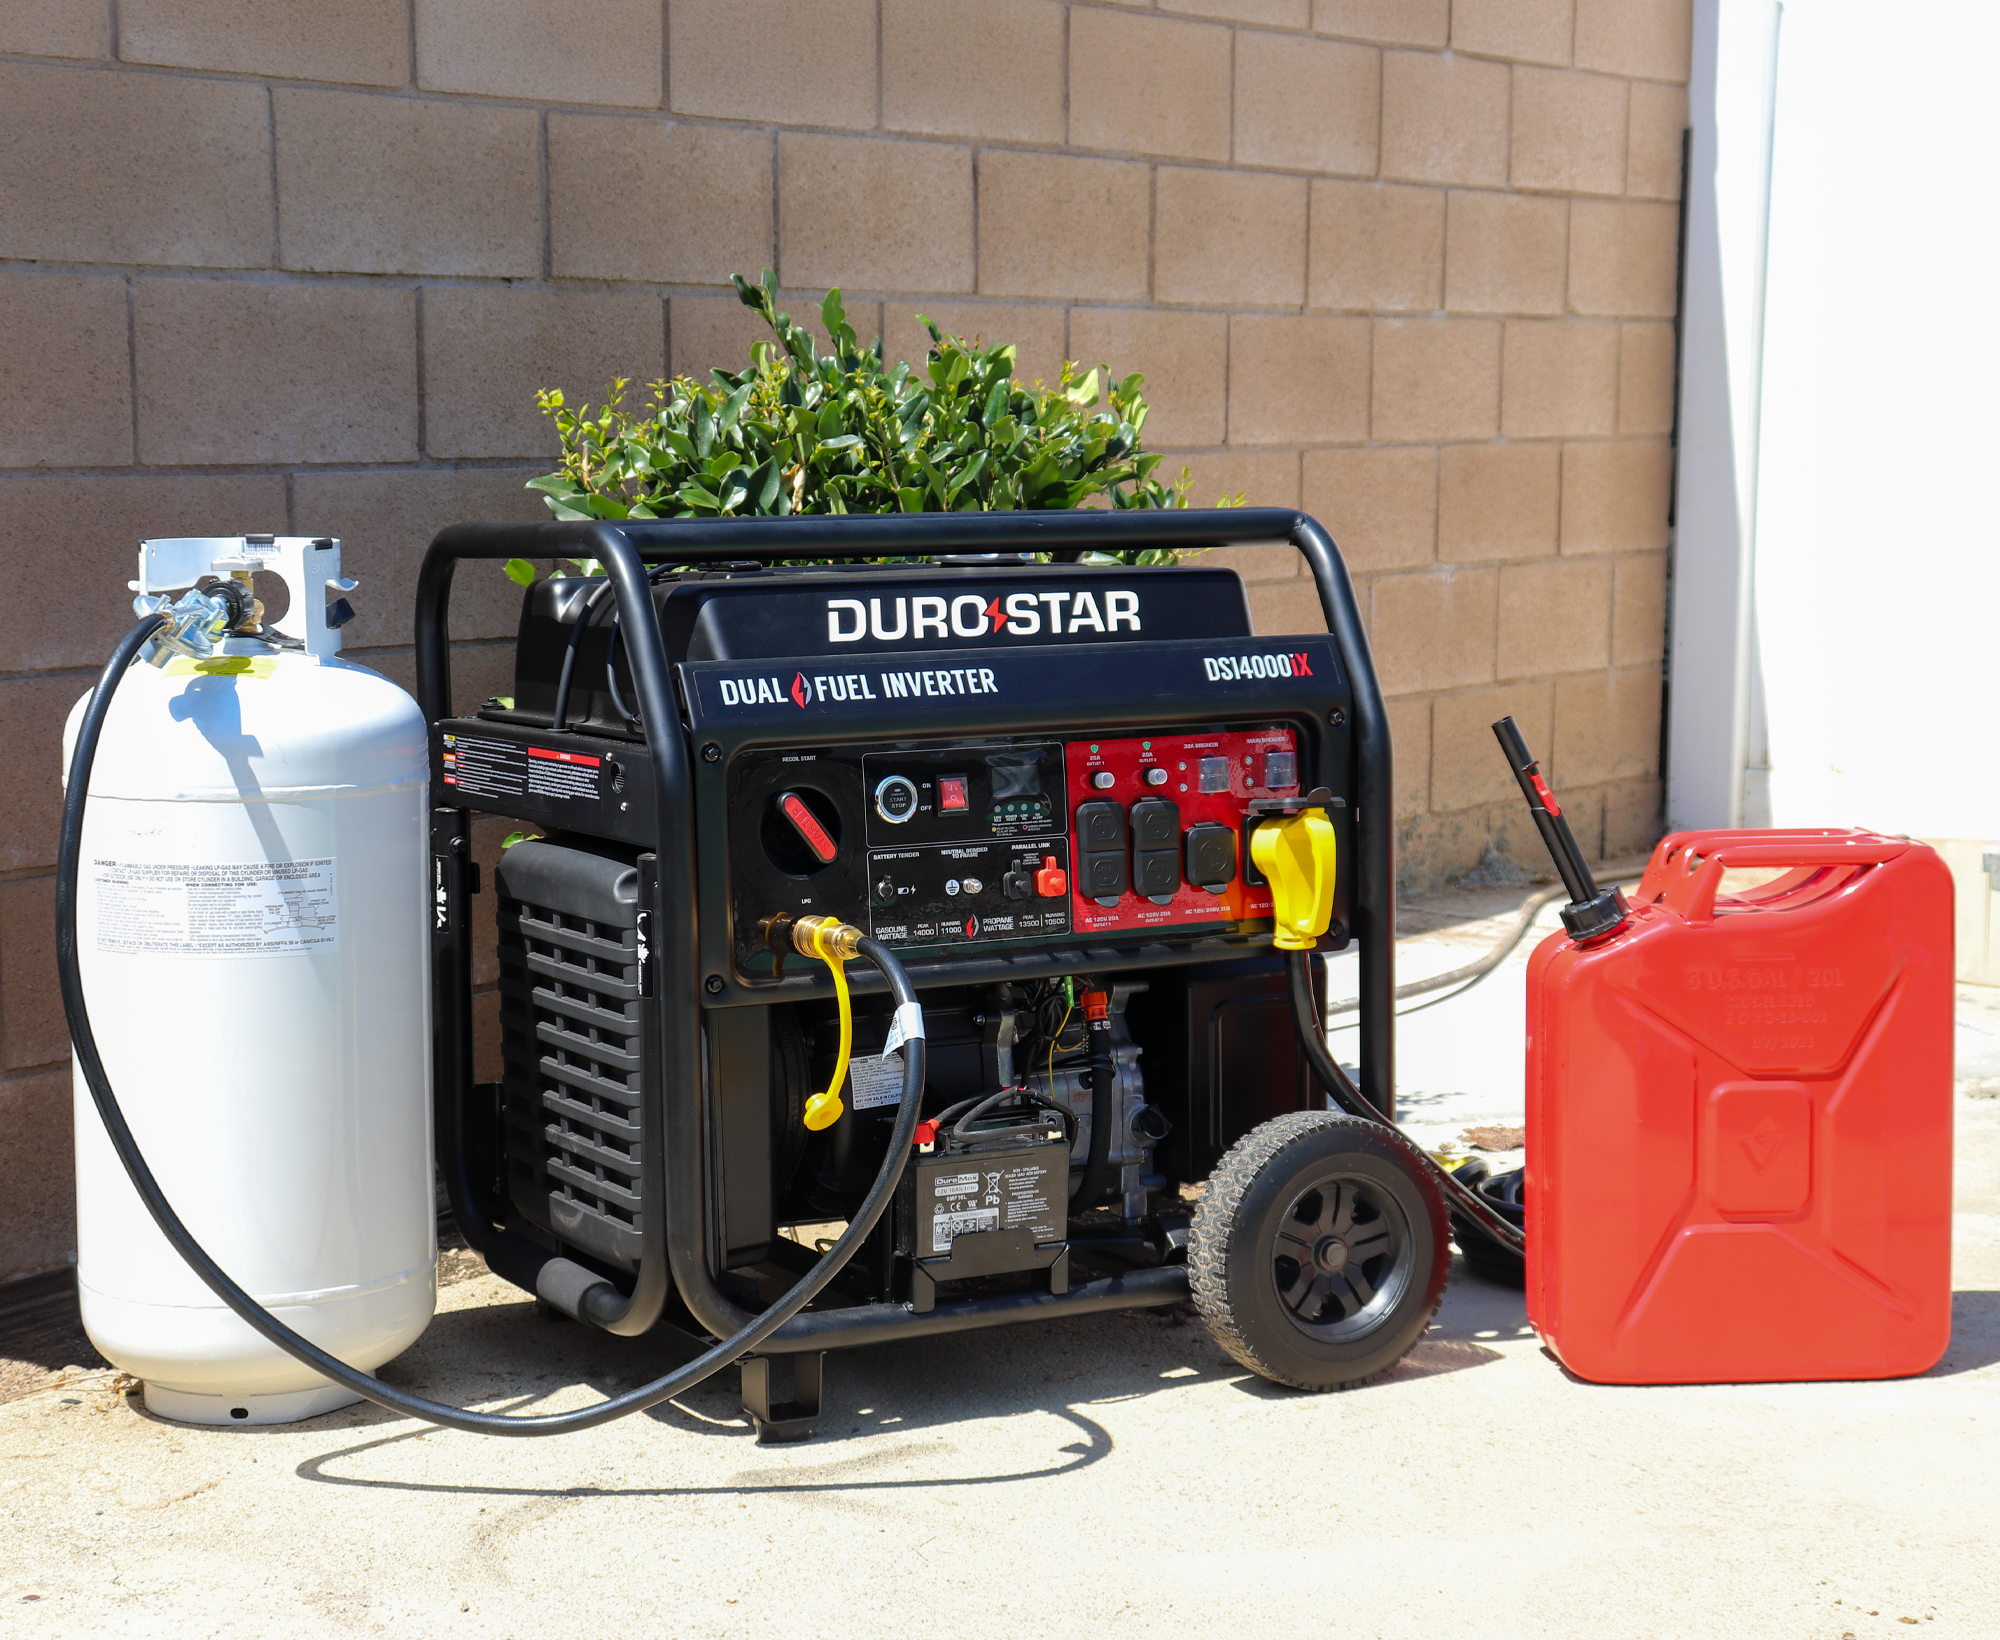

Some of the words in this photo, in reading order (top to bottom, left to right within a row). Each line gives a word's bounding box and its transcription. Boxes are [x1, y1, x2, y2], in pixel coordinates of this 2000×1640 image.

[1204, 651, 1314, 682] DS14000iX
[720, 677, 790, 706] DUAL
[814, 674, 877, 702] FUEL
[881, 668, 1000, 699] INVERTER
[792, 804, 830, 853] STARTER
[983, 916, 1014, 925] PROPANE
[1019, 920, 1040, 928] 13500
[1044, 917, 1066, 926] 10500
[876, 925, 908, 934] GASOLINE
[983, 923, 1014, 932] WATTAGE
[878, 932, 908, 941] WATTAGE
[1808, 967, 1844, 987] 20L
[1751, 1034, 1814, 1050] 07/2021
[937, 1175, 977, 1185] DuroMax
[986, 1195, 1000, 1206] Pb
